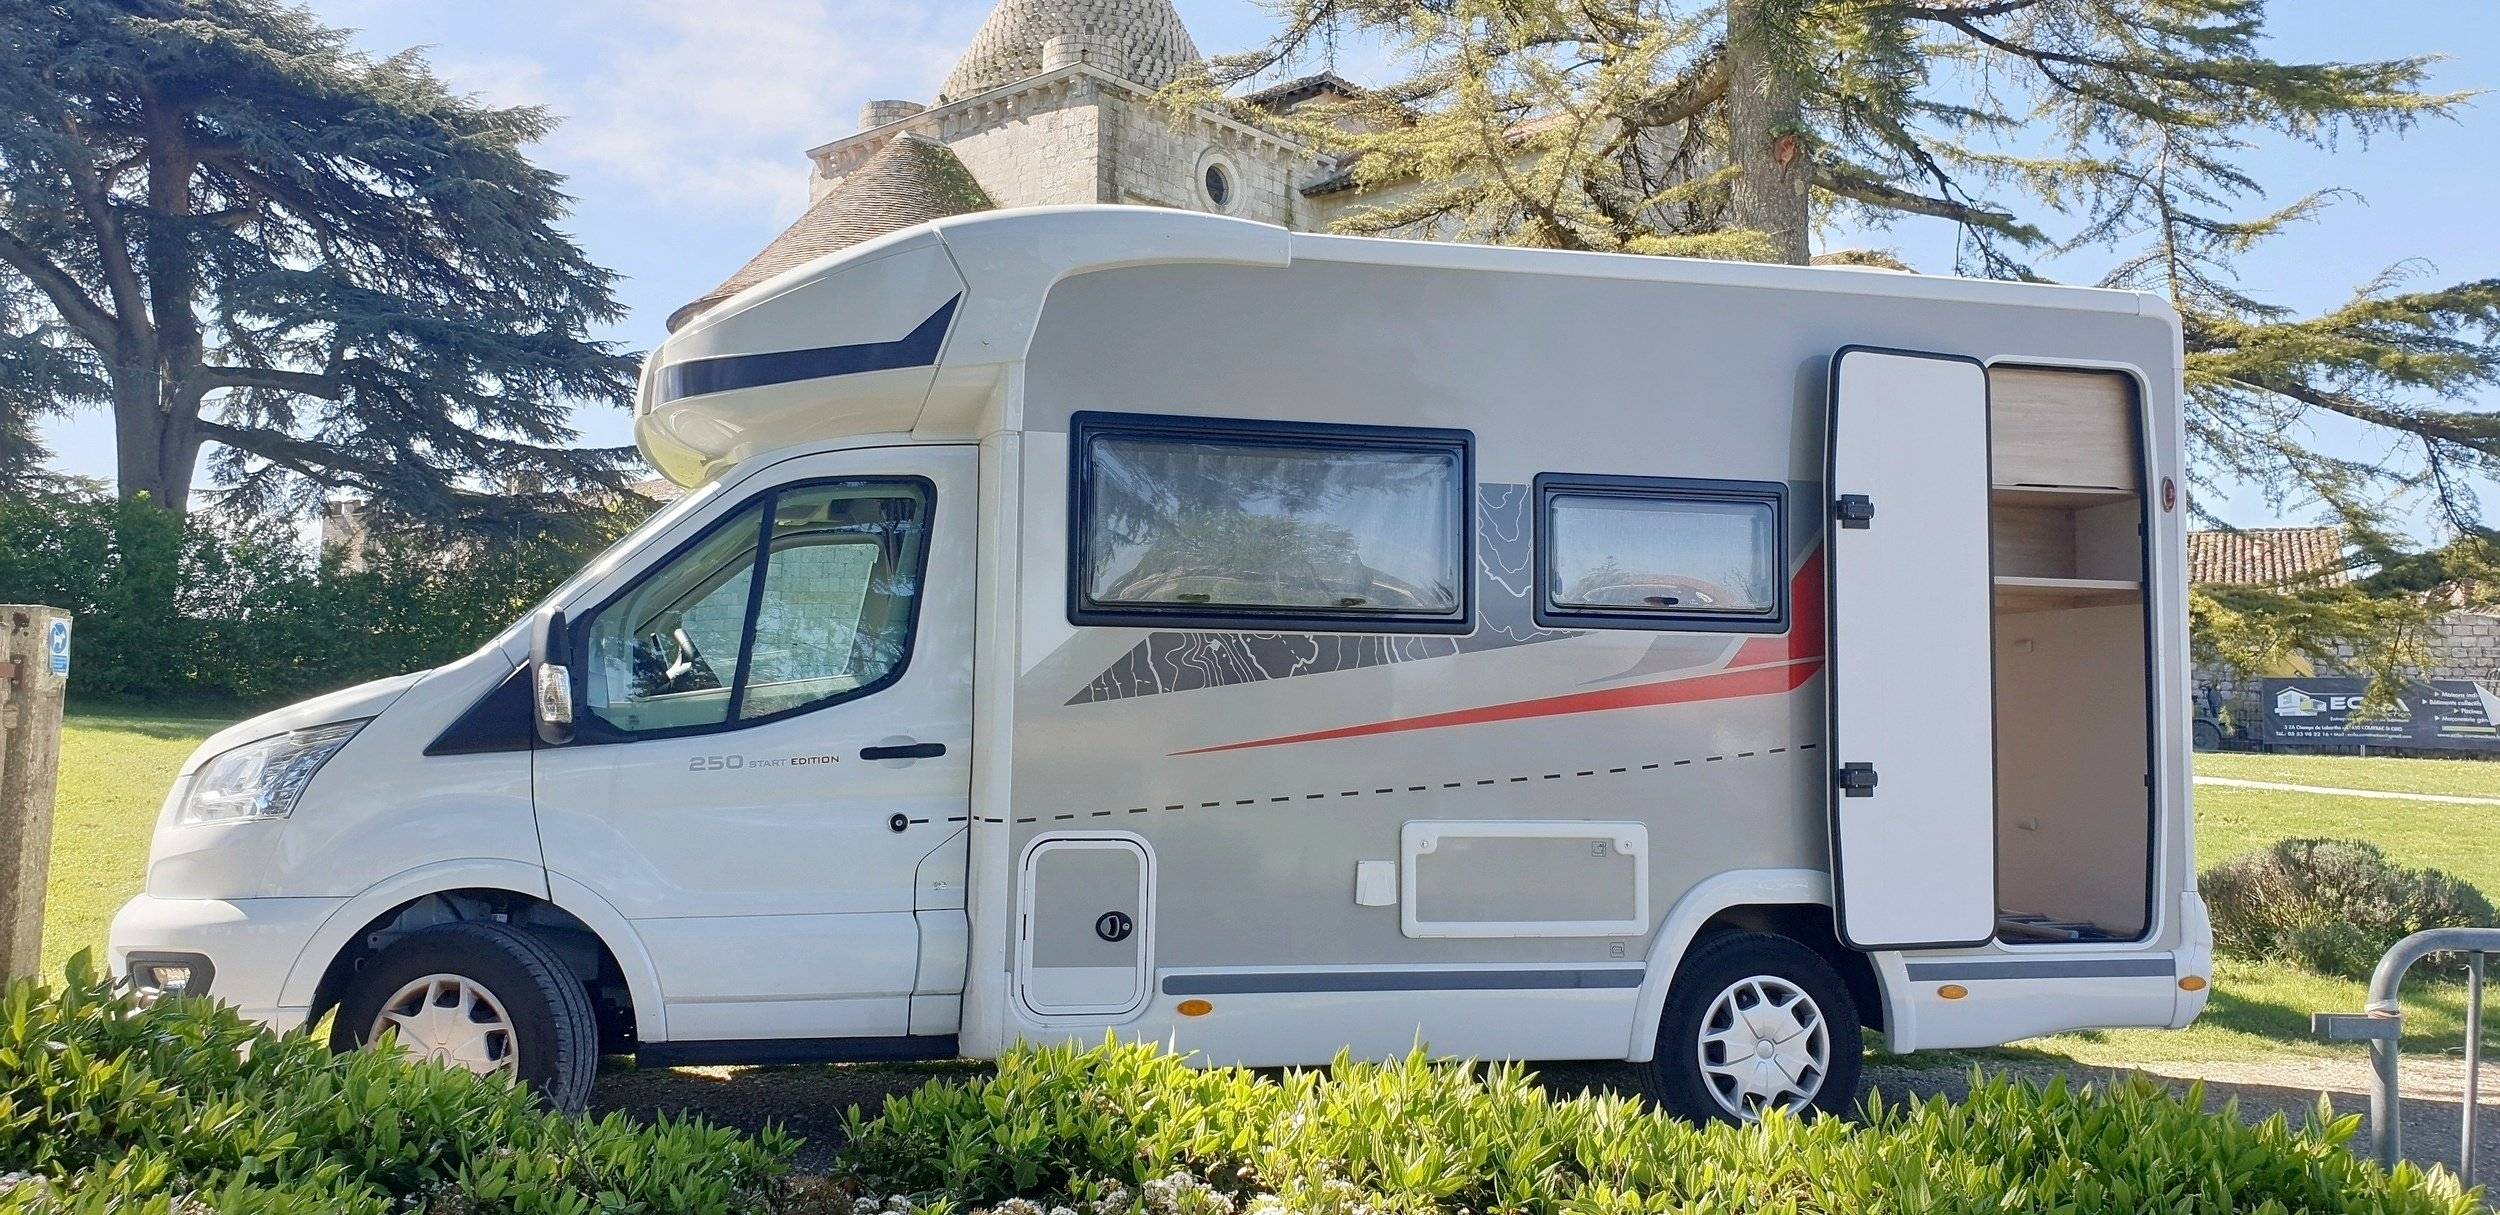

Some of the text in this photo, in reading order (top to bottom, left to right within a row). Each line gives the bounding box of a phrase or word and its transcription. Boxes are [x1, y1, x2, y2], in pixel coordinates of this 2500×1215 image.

[689, 755, 840, 771] 250 START EDITION
